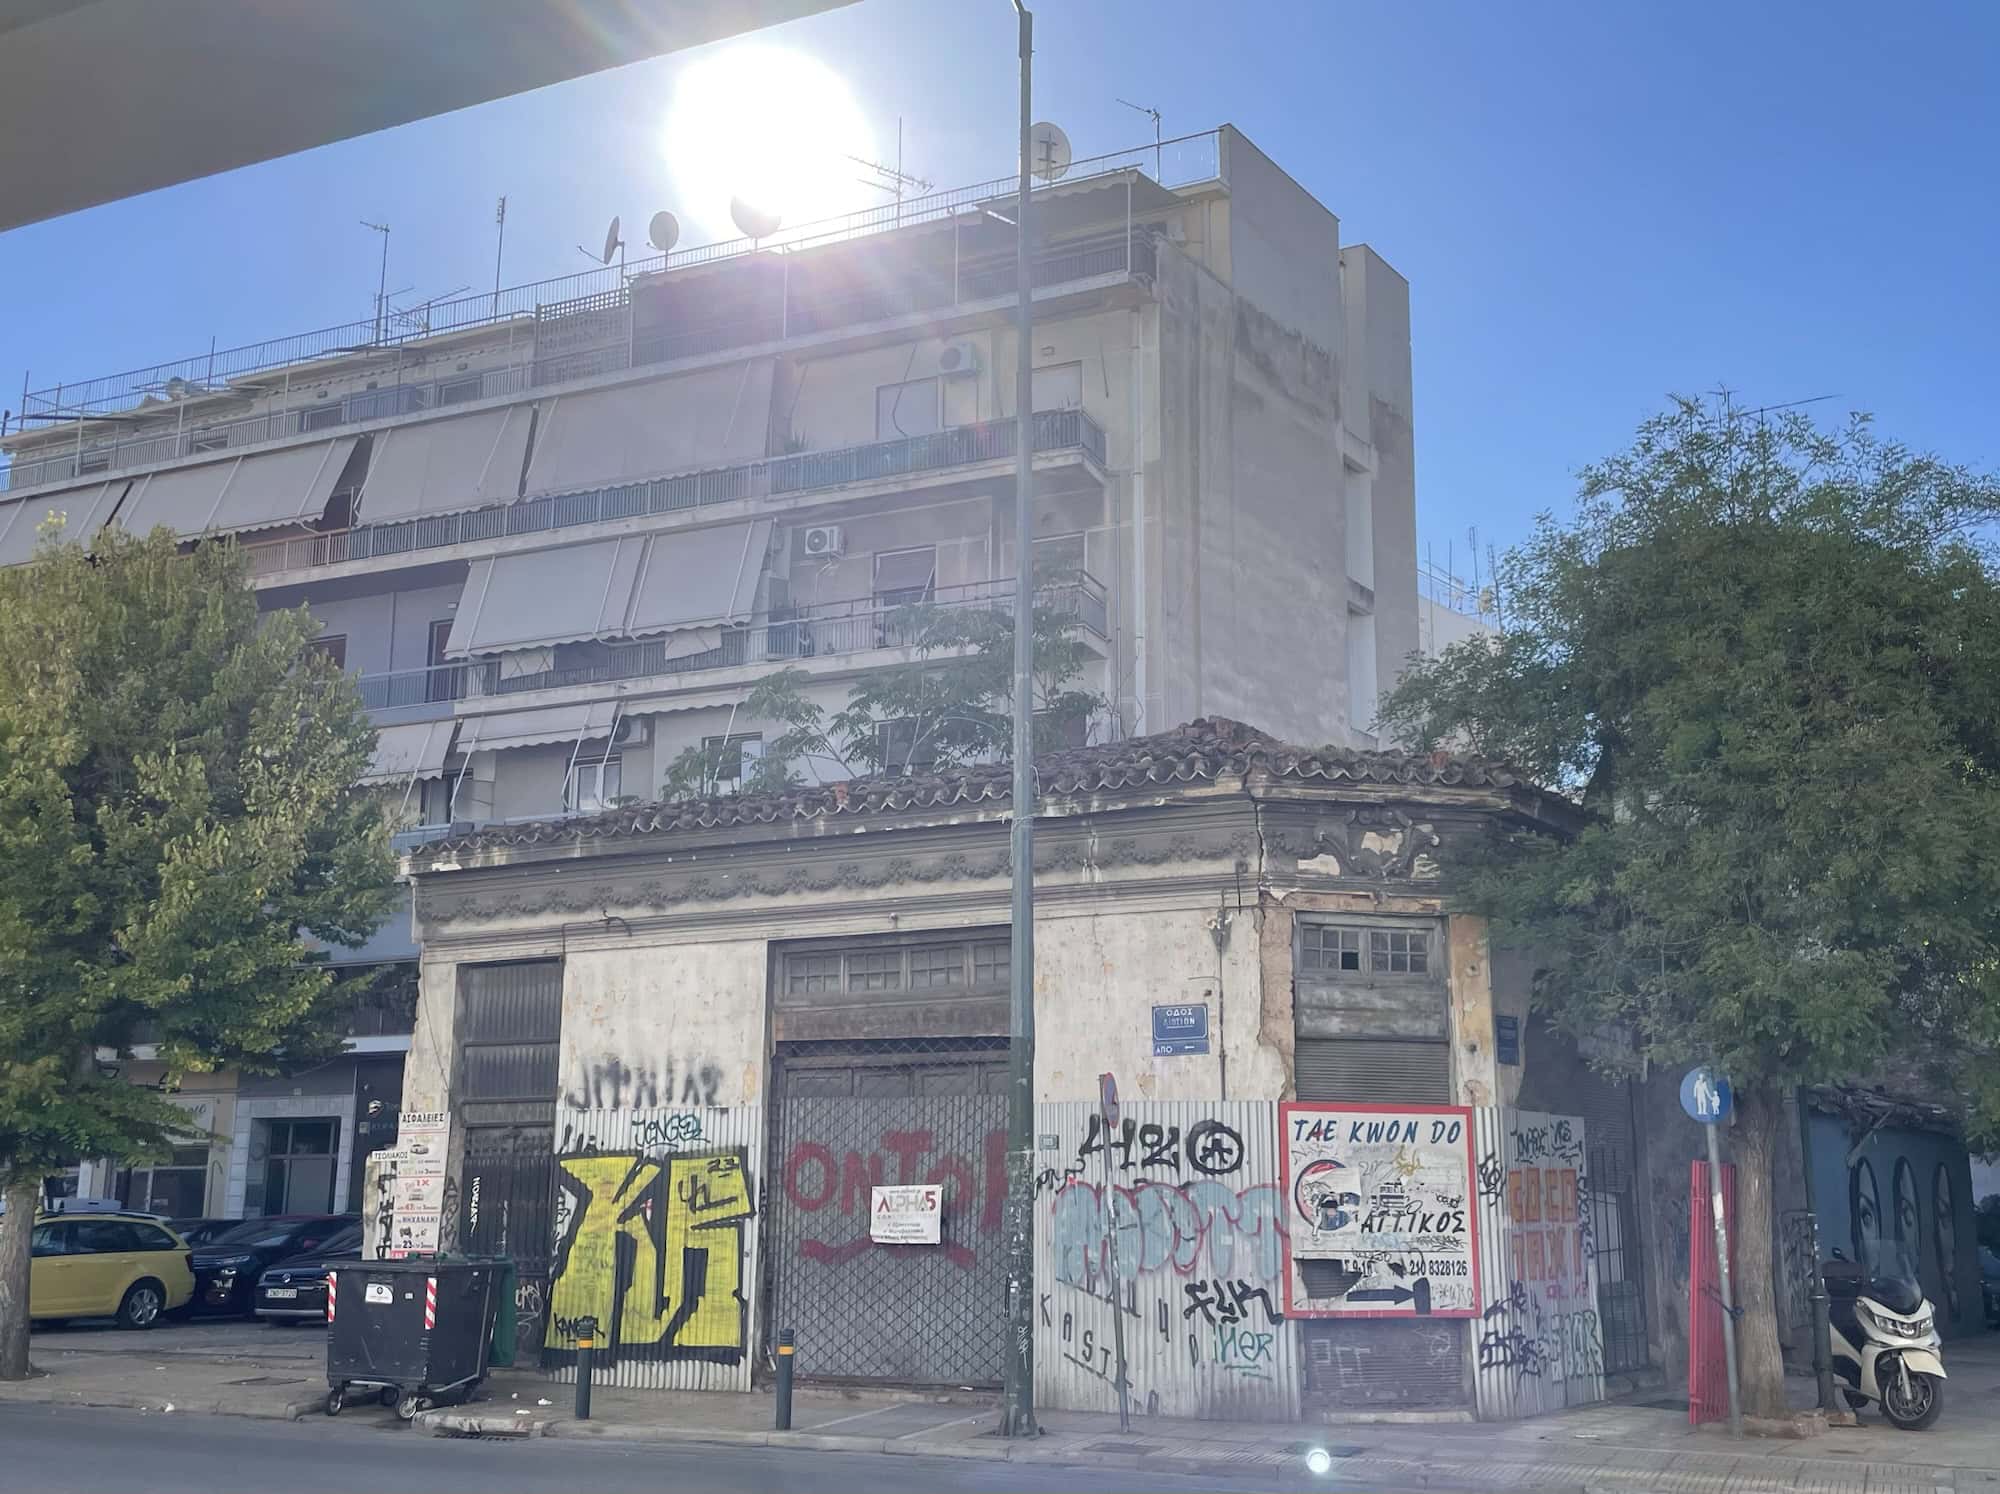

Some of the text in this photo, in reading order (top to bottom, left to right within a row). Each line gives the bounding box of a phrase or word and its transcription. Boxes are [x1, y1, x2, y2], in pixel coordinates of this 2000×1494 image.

[1166, 1008, 1193, 1017] ΟΔΟΣ
[402, 1113, 444, 1123] ΑΣΦΑΛΕΙΕΣ
[1294, 1118, 1461, 1144] TAE KWON DO
[1429, 1260, 1467, 1276] 8328126
